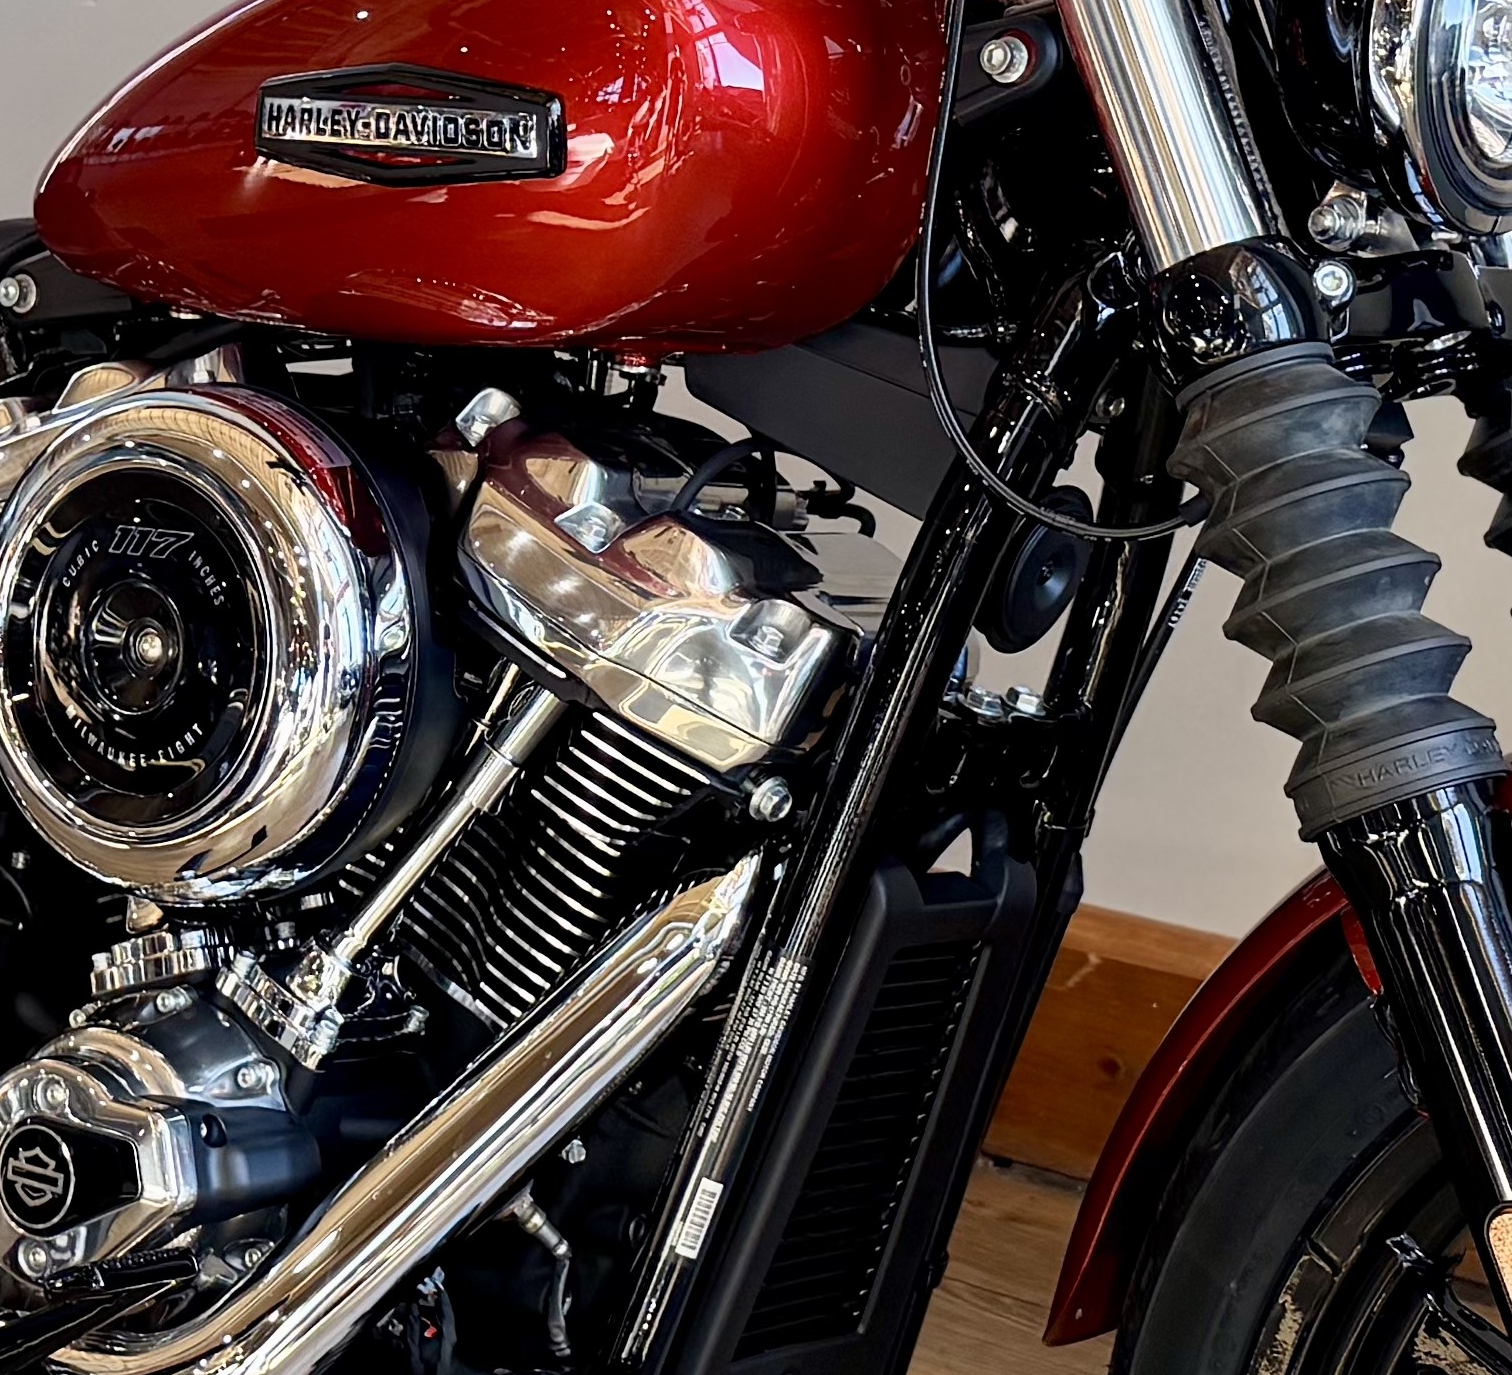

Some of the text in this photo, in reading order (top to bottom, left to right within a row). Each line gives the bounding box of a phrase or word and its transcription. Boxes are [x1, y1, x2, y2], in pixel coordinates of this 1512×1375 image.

[266, 100, 534, 154] HARLEY-DAVIDSON
[62, 540, 99, 588] CUBIC
[108, 525, 195, 559] 117
[188, 549, 225, 606] INCHES
[65, 703, 203, 768] MILWAUKEE-EIGHT
